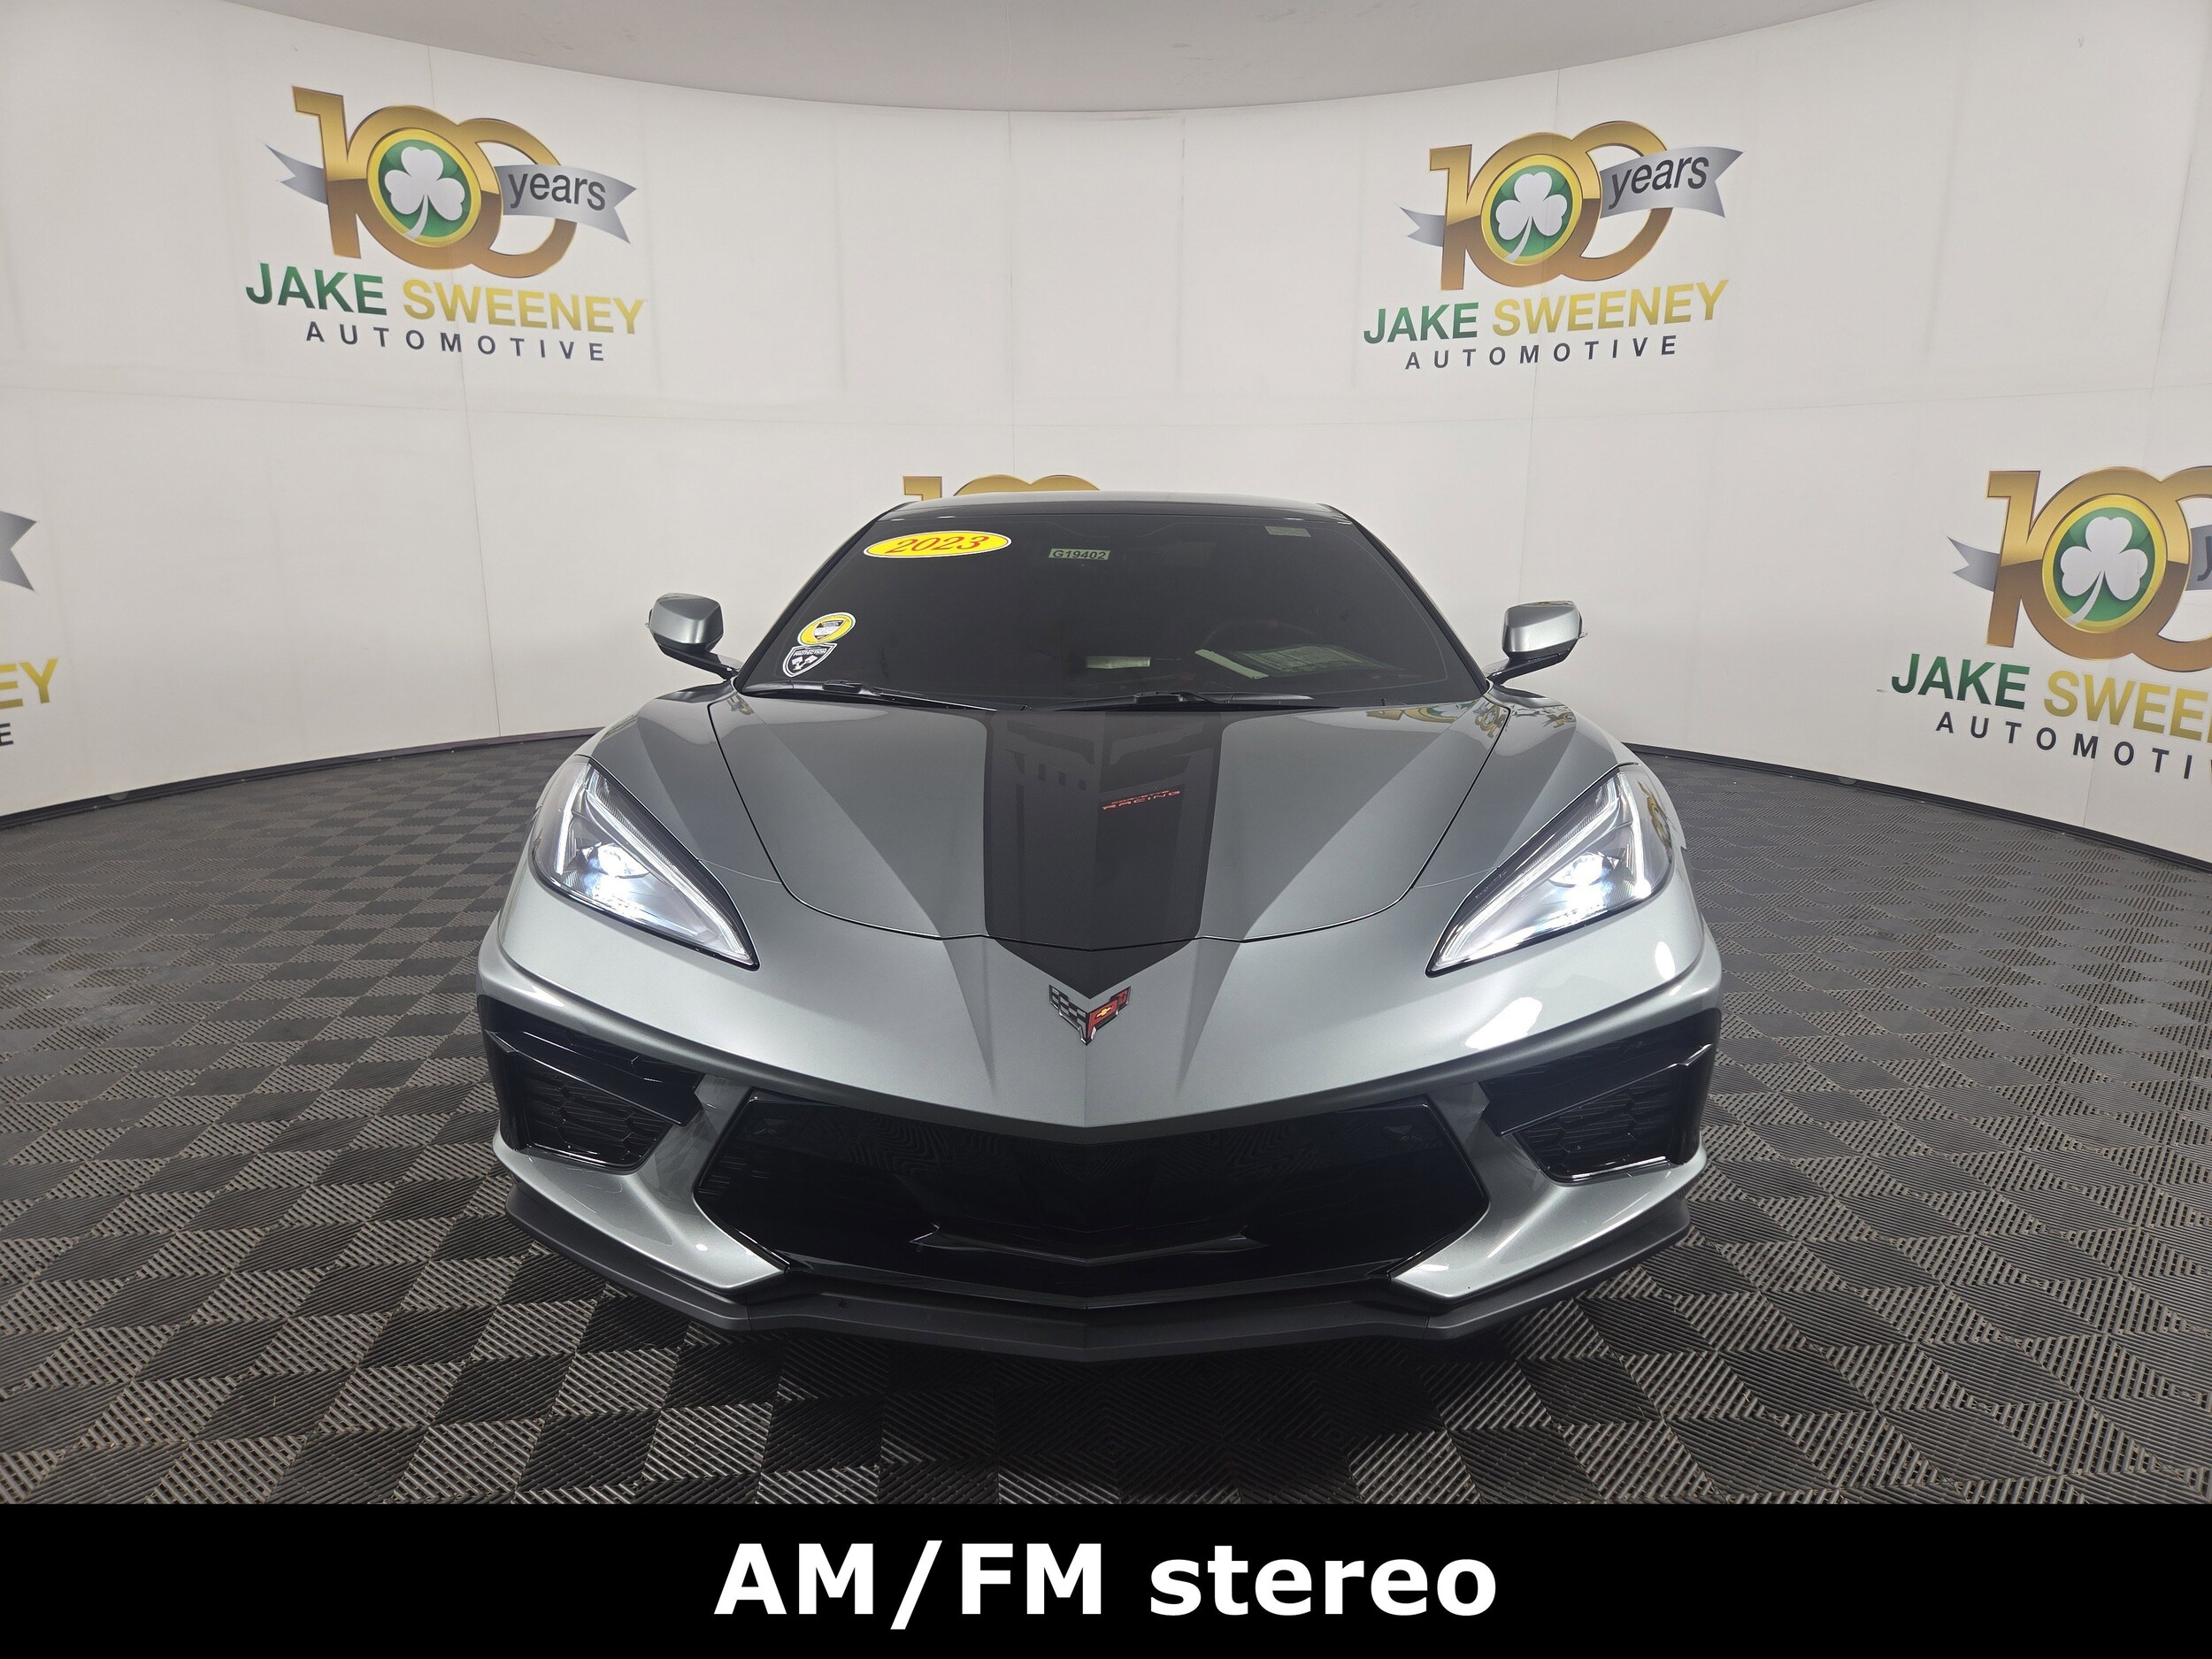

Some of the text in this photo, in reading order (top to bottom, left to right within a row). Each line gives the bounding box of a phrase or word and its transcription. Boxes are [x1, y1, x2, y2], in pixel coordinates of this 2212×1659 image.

[292, 86, 606, 279] 100 years
[1429, 120, 1709, 290] 100 years
[245, 263, 644, 334] JAKE SWEENEY
[1363, 279, 1729, 344] JAKE SWEENEY
[306, 321, 604, 361] AUTOMOTIVE
[1405, 334, 1677, 370] AUTOMOTIVE
[885, 536, 990, 554] 2023
[1053, 549, 1106, 560] G19402
[1891, 653, 2212, 745] JAKE SWEE
[1936, 711, 2212, 784] AUTOMOTI
